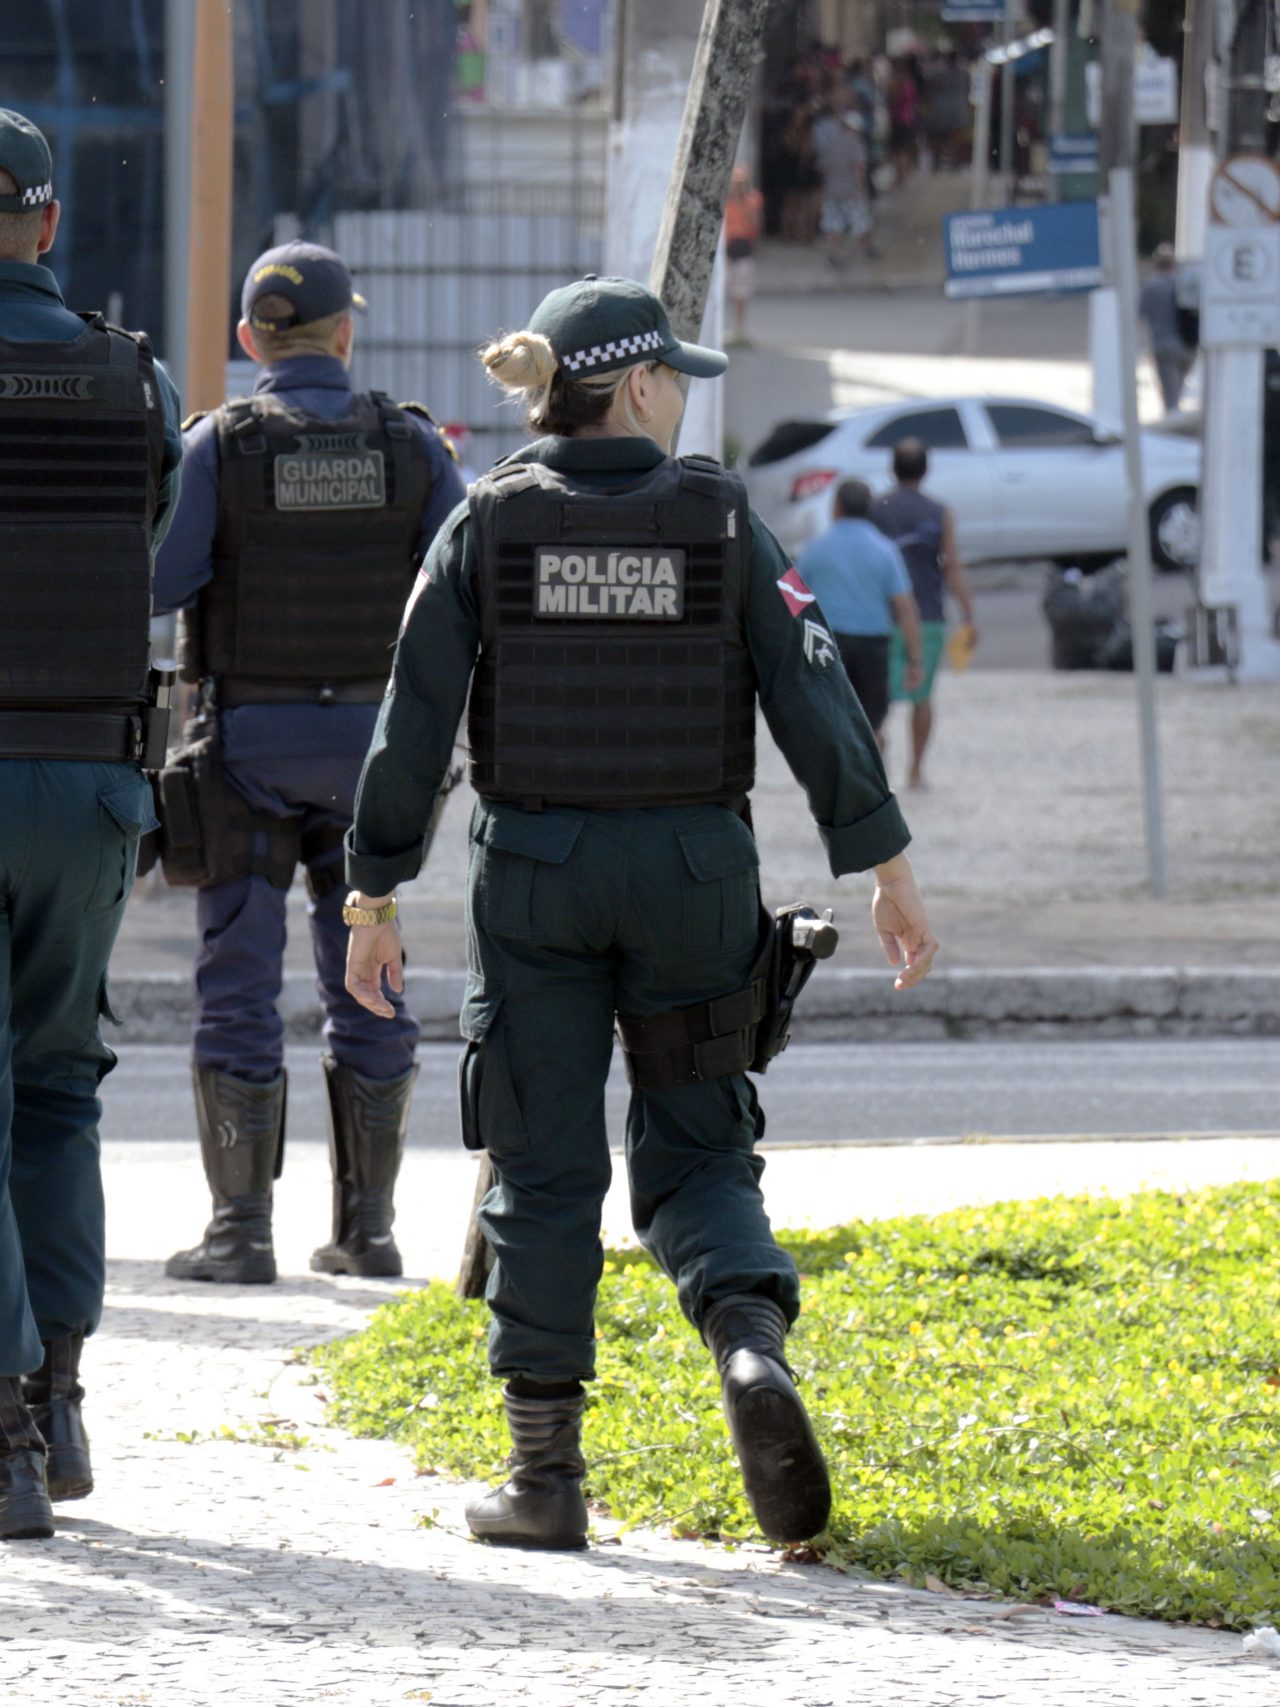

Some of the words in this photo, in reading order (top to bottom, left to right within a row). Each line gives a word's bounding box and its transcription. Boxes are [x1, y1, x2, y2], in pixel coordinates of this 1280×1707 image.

[1234, 247, 1256, 281] E
[283, 458, 377, 481] GUARDA
[279, 480, 381, 504] MUNICIPAL
[539, 553, 678, 585] POLÍCIA
[538, 585, 678, 615] MILITAR
